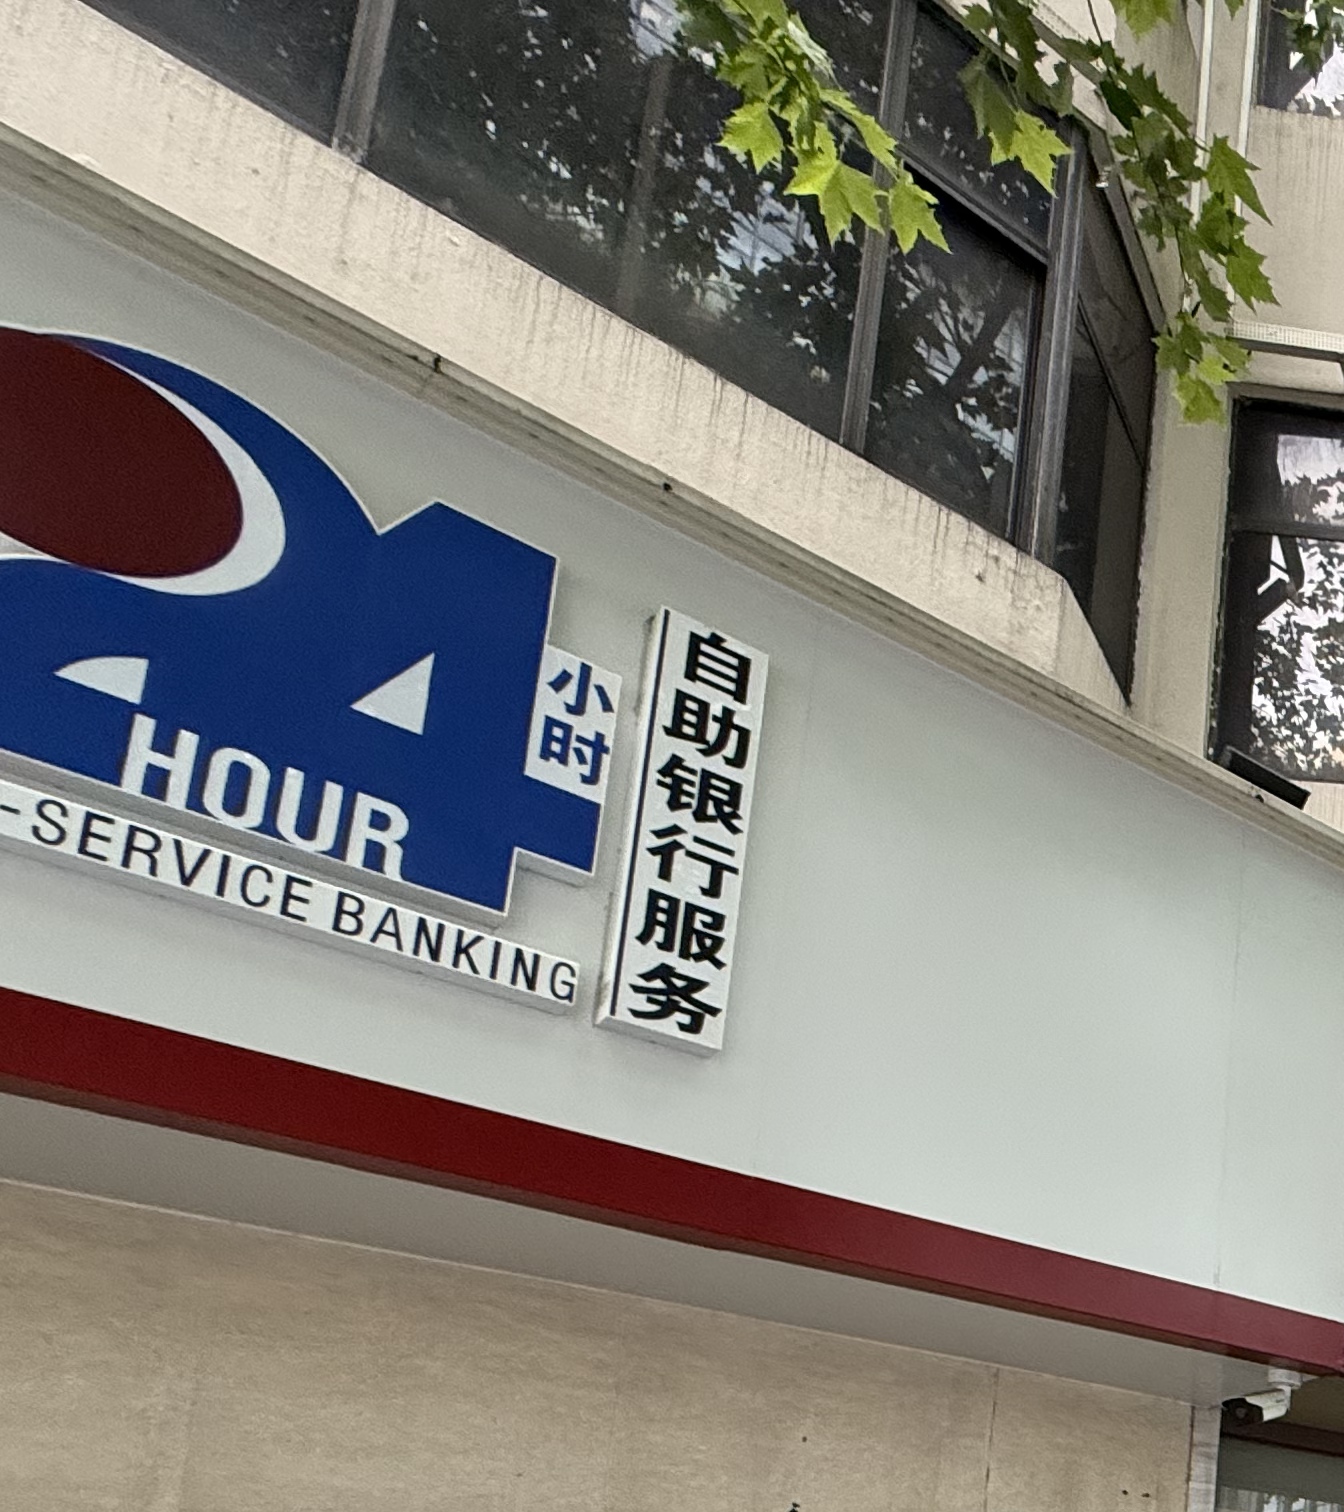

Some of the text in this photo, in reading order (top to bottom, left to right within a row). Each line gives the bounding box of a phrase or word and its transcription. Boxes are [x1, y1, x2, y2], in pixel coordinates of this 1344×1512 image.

[120, 711, 411, 884] HOUR
[539, 661, 615, 787] 小时
[628, 631, 751, 1036] 自助银行服务
[331, 890, 577, 1004] BANKING
